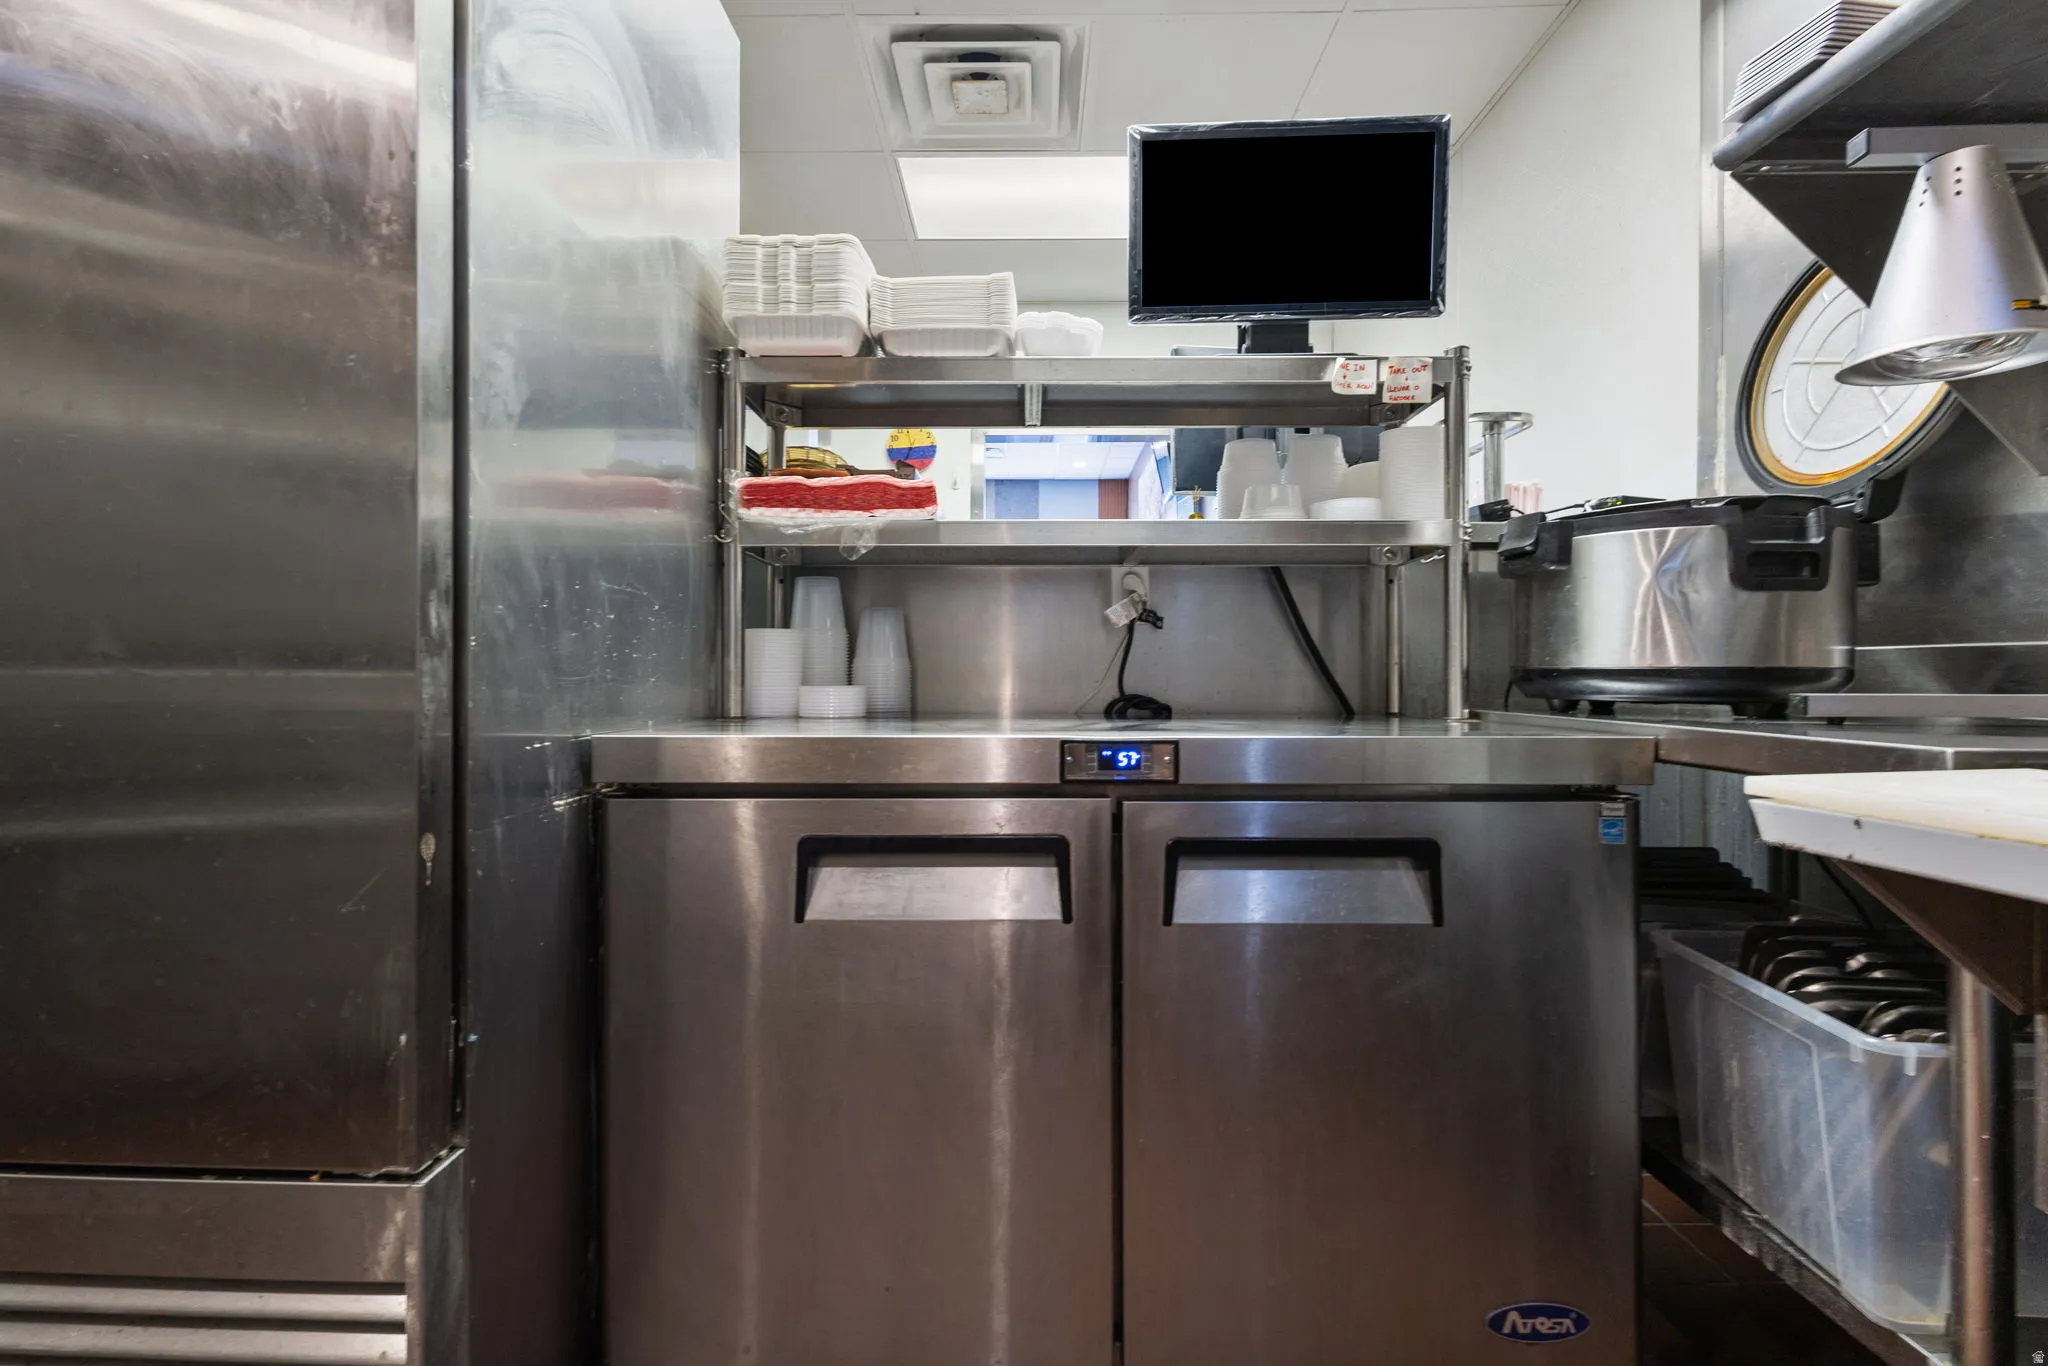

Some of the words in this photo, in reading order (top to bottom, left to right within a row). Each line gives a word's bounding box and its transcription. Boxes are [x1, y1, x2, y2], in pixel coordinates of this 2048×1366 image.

[1353, 363, 1365, 371] IN
[1388, 365, 1407, 376] TAKE
[1411, 364, 1429, 373] OUT
[890, 434, 899, 442] 10
[926, 431, 932, 439] 2
